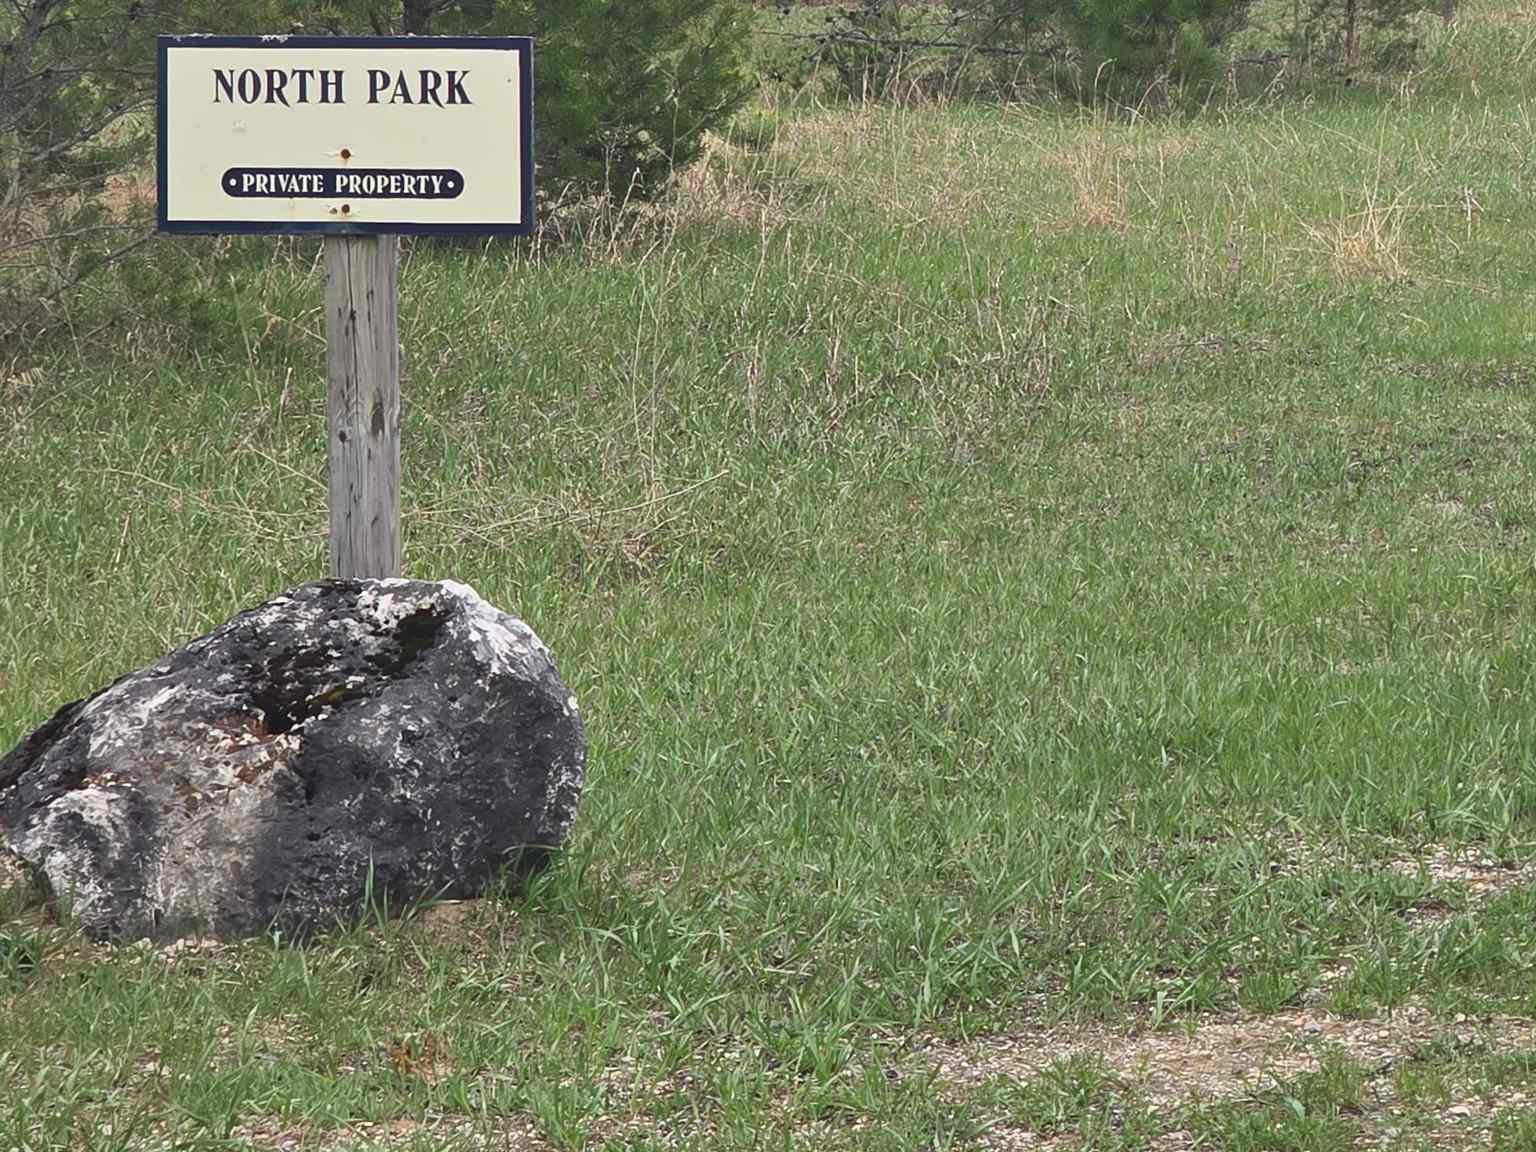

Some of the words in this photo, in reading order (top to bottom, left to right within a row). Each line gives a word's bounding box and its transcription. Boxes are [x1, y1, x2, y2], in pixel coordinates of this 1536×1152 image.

[213, 68, 345, 107] NORTH
[366, 69, 473, 109] PARK
[241, 173, 324, 194] PRIVATE
[335, 173, 444, 196] PROPERTY
